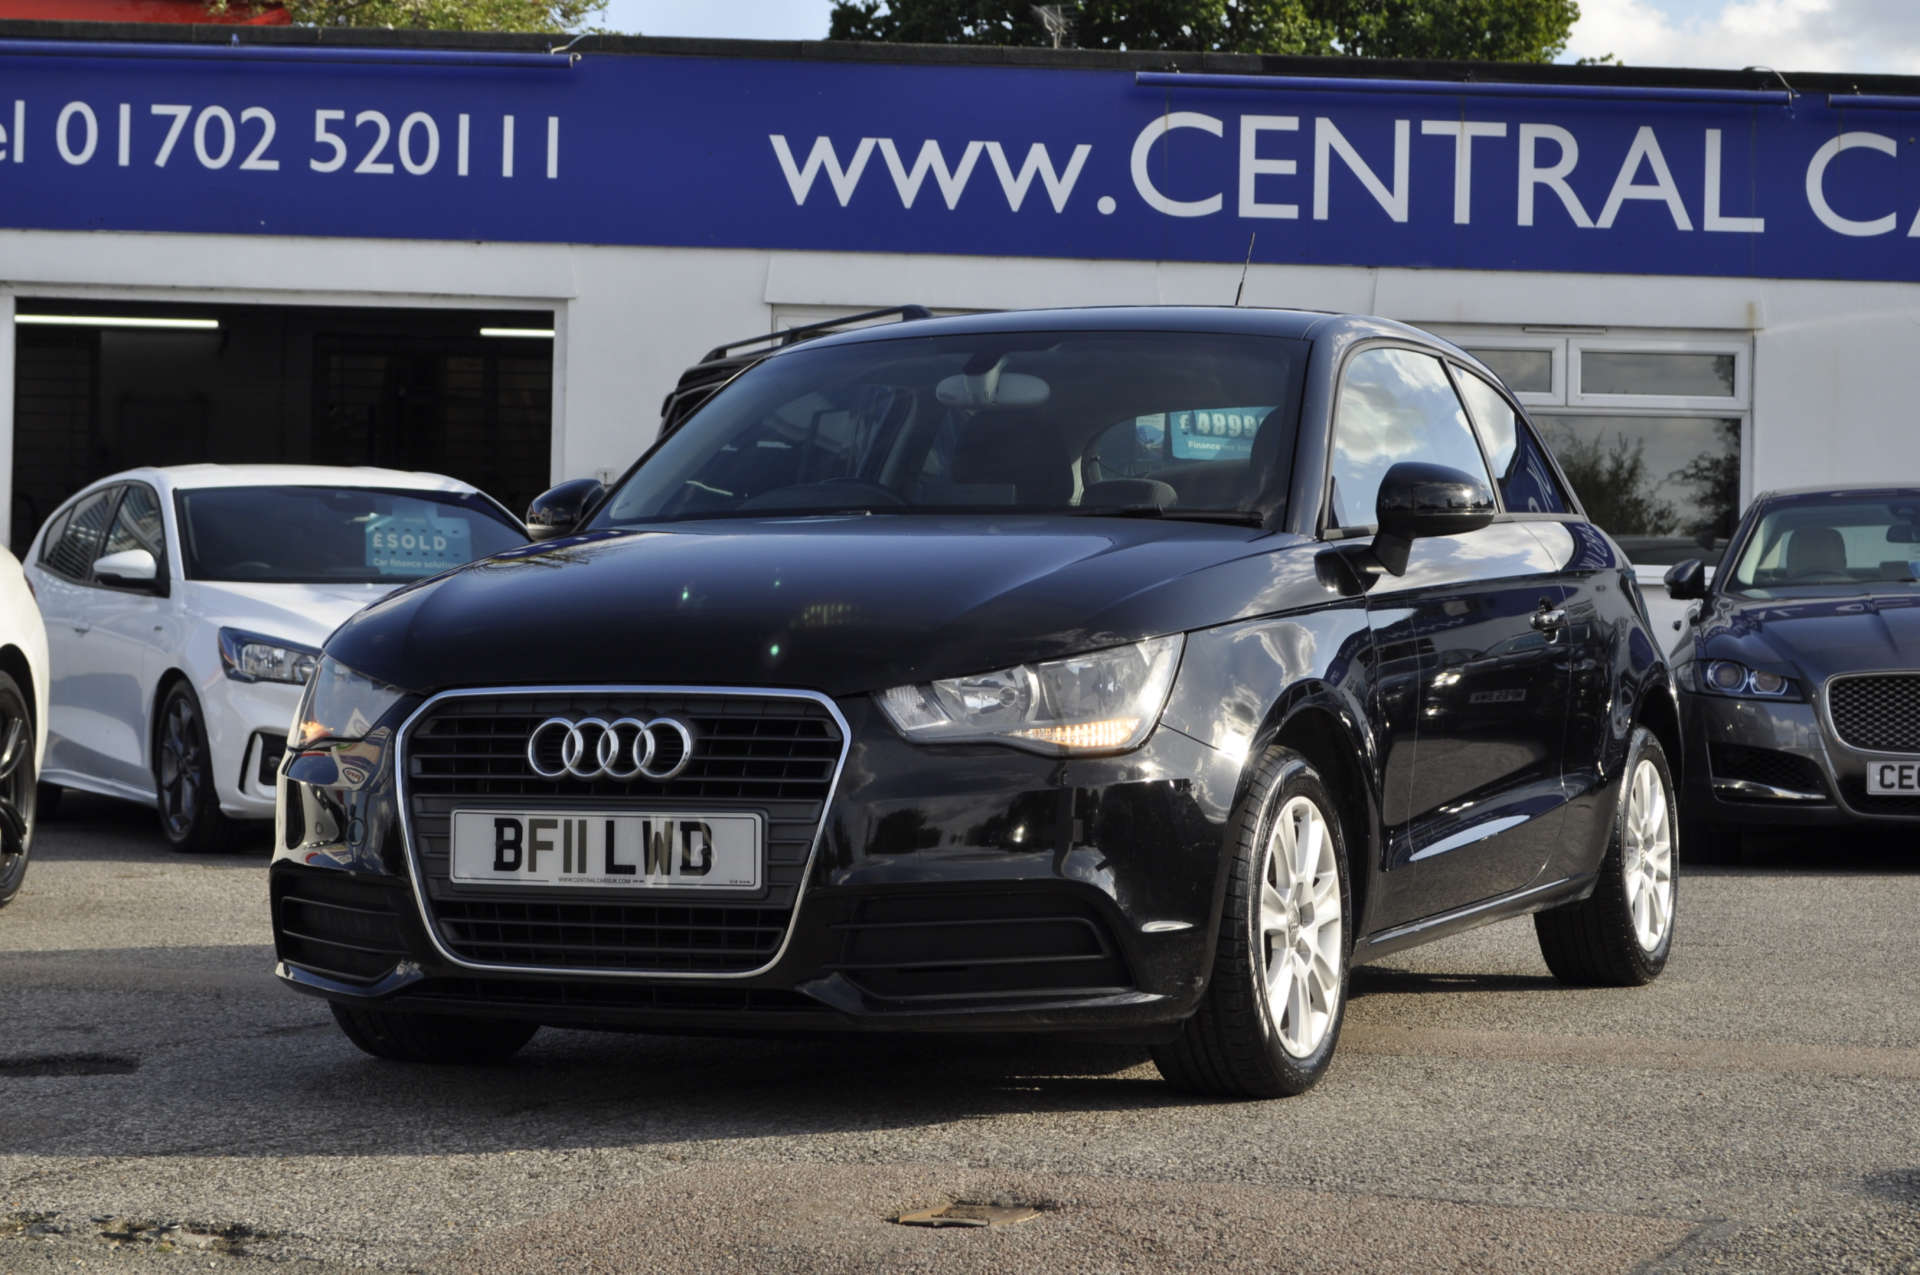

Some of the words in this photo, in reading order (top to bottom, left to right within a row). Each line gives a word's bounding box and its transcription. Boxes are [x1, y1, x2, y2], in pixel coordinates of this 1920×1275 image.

[56, 101, 280, 171] 01702
[309, 109, 559, 179] 520111
[1805, 131, 1920, 237] C
[1879, 765, 1920, 789] CE
[605, 819, 713, 876] LWD
